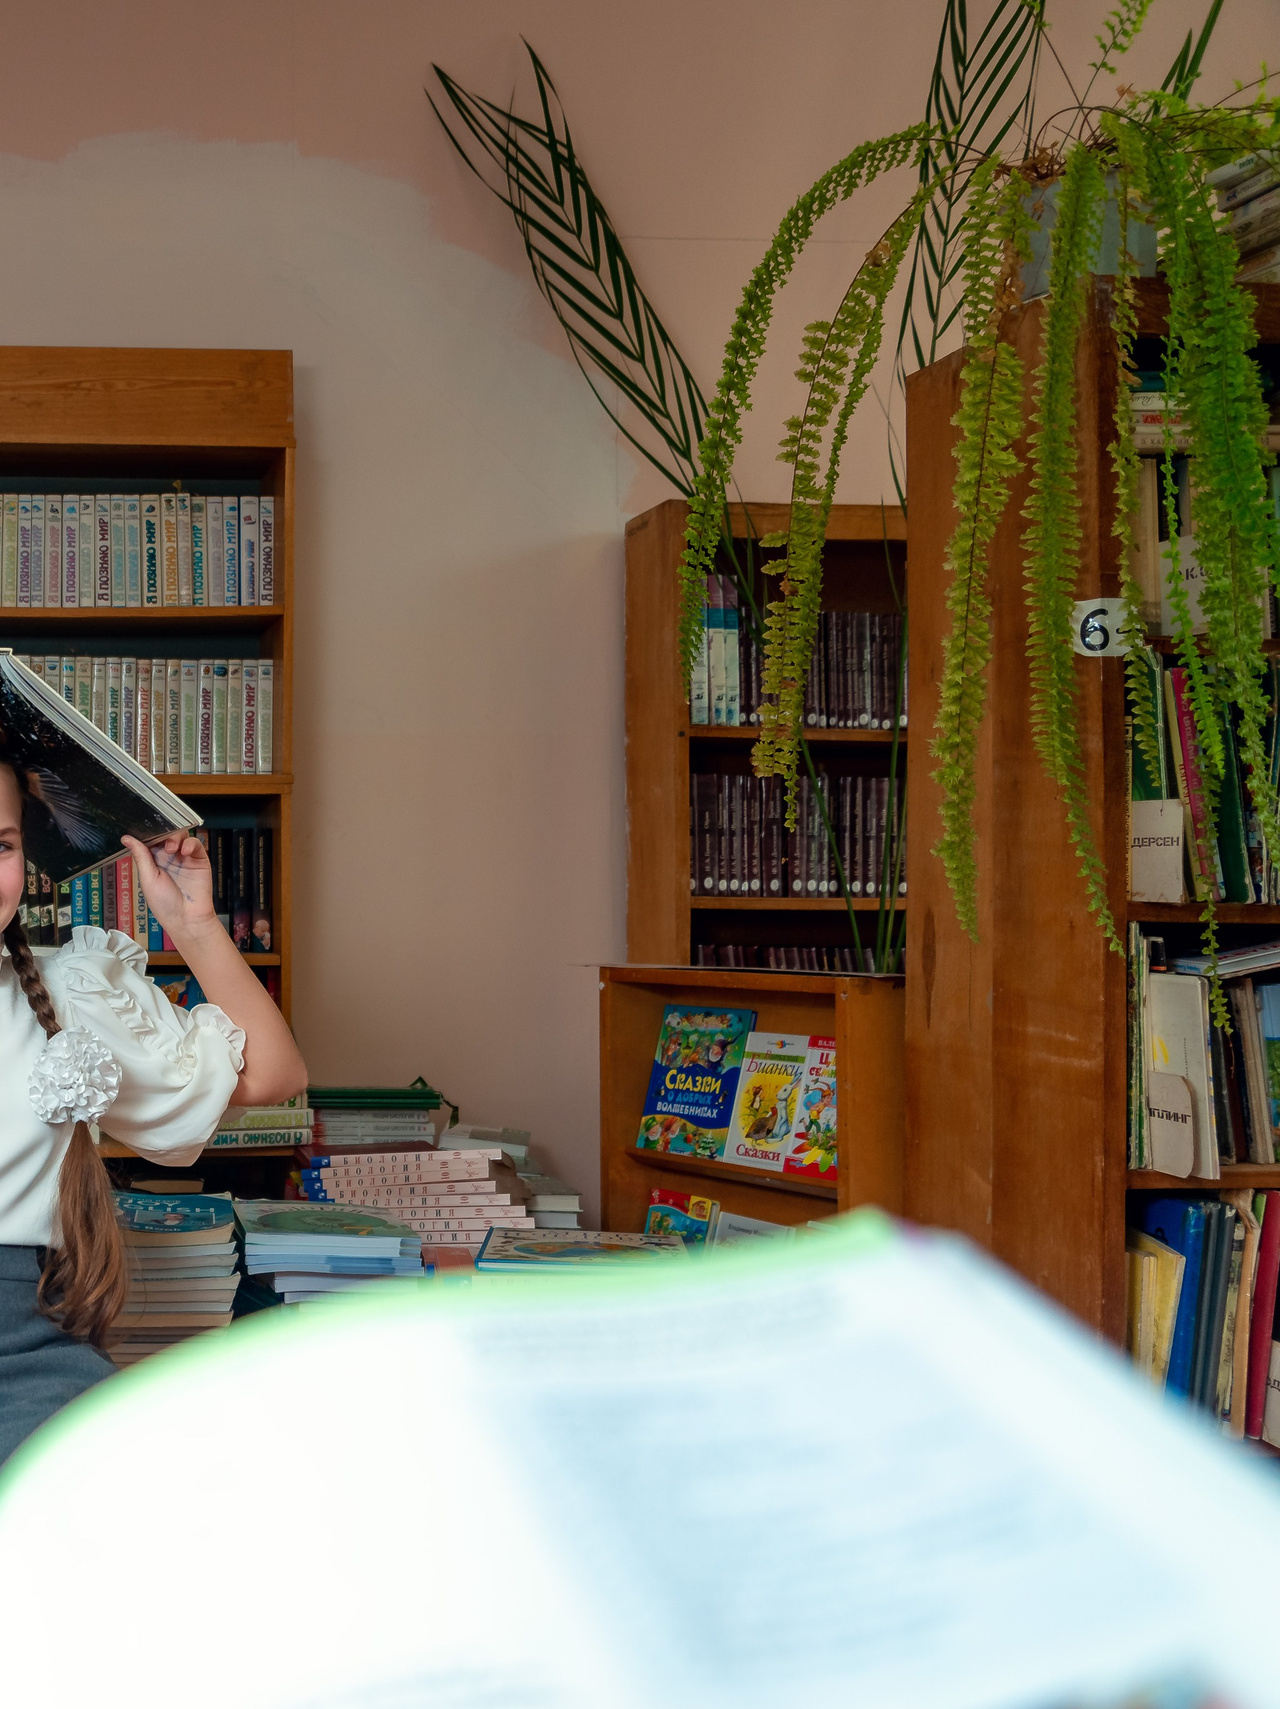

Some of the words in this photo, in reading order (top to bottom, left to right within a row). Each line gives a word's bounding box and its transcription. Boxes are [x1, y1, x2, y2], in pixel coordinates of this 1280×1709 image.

[99, 517, 109, 542] МИР
[145, 519, 156, 545] МИР
[225, 520, 236, 546] МИР
[262, 519, 273, 543] МИР
[98, 544, 109, 590] ПОЗНАЮ
[146, 546, 157, 593] ПОЗНАЮ
[225, 547, 237, 593] ПОЗНАЮ
[261, 545, 273, 591] ПОЗНАЮ
[97, 593, 109, 602] Я
[145, 595, 157, 605] Я
[225, 595, 237, 604] Я
[261, 594, 272, 602] Я
[1080, 608, 1109, 651] 6
[202, 687, 211, 711] МИР
[245, 683, 256, 708] МИР
[200, 712, 211, 755] ПОЗНАЮ
[244, 710, 255, 758] ПОЗНАЮ
[200, 757, 210, 765] Я
[243, 760, 254, 768] Я
[1131, 836, 1180, 849] ДЕРСЕН
[122, 891, 130, 912] ОБО
[137, 914, 147, 934] ВСЁ
[747, 1053, 803, 1077] Бианки
[809, 1066, 836, 1079] СЕМИ
[675, 1092, 713, 1105] ДОБРЫХ
[656, 1101, 718, 1118] ВОЛШЕБНИКАХ
[242, 1132, 291, 1145] ПОЗНАЮ
[343, 1153, 434, 1165] БИОЛОГИЯ
[736, 1143, 781, 1162] Сказки
[332, 1164, 421, 1177] БИОЛОГИЯ
[335, 1174, 422, 1188] БИОЛОГИЯ
[339, 1186, 428, 1198] БИОЛОГИЯ
[123, 1204, 215, 1213] GLISH
[398, 1208, 455, 1218] ЛОГИЯ
[344, 1226, 373, 1236] 7
[408, 1220, 463, 1229] ОГИЯ
[427, 1232, 471, 1242] ОГИЯ
